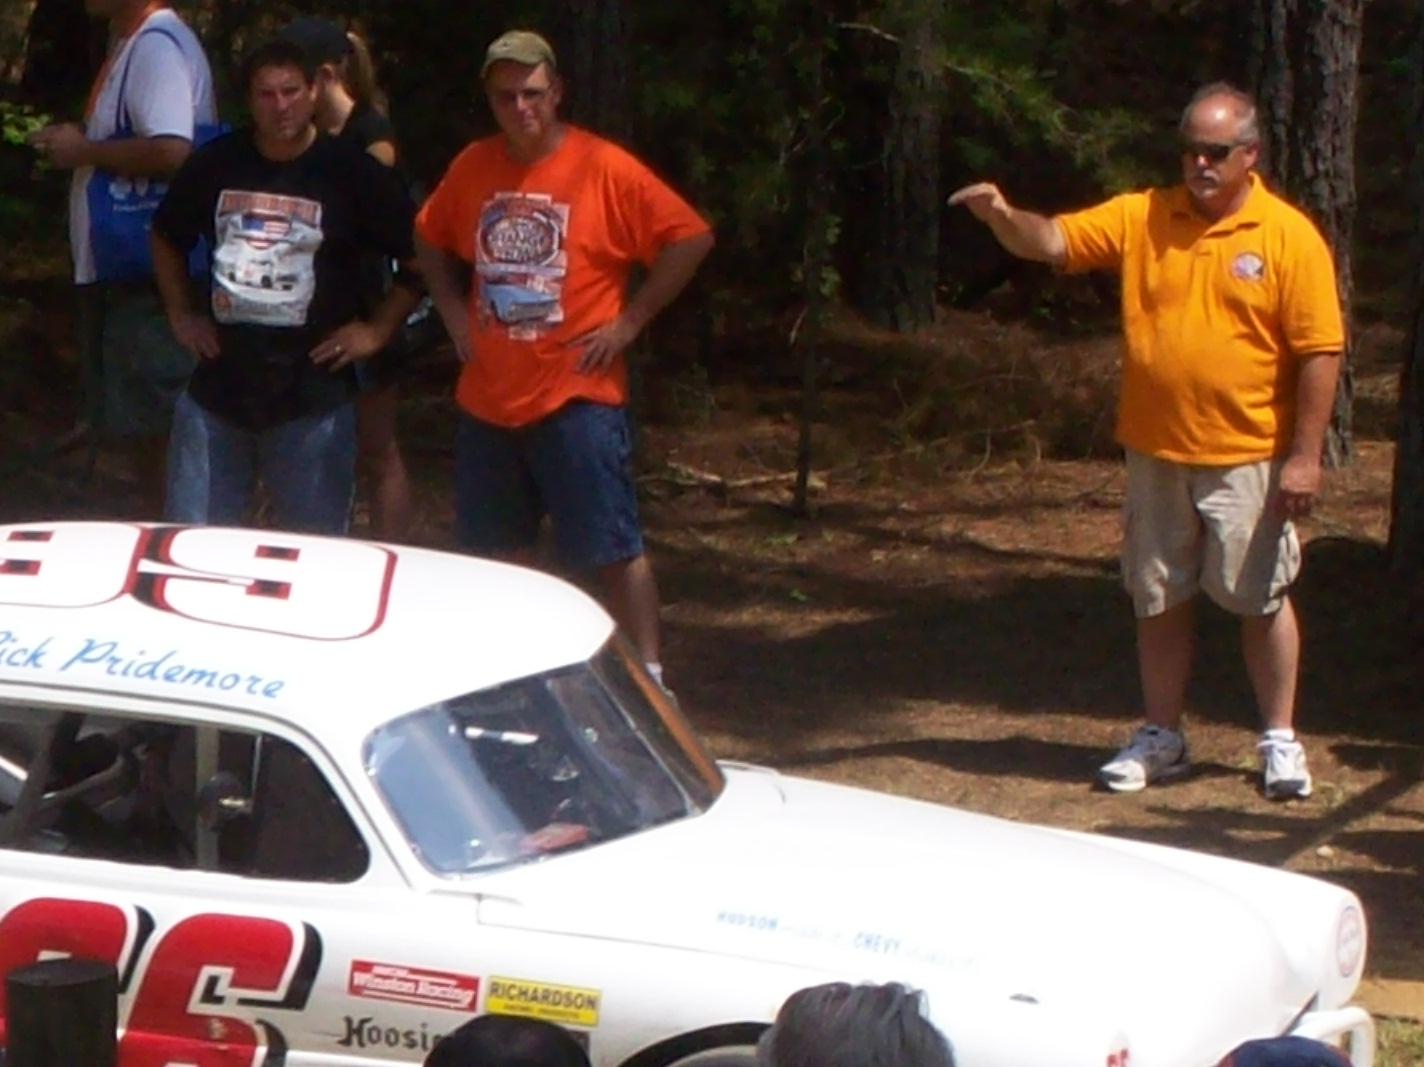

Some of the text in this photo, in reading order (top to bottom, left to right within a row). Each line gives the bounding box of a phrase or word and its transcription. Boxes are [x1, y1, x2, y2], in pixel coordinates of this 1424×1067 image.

[61, 637, 286, 699] Pridemore
[489, 981, 597, 1010] RICHARDSON
[336, 1015, 442, 1051] Hoosi
